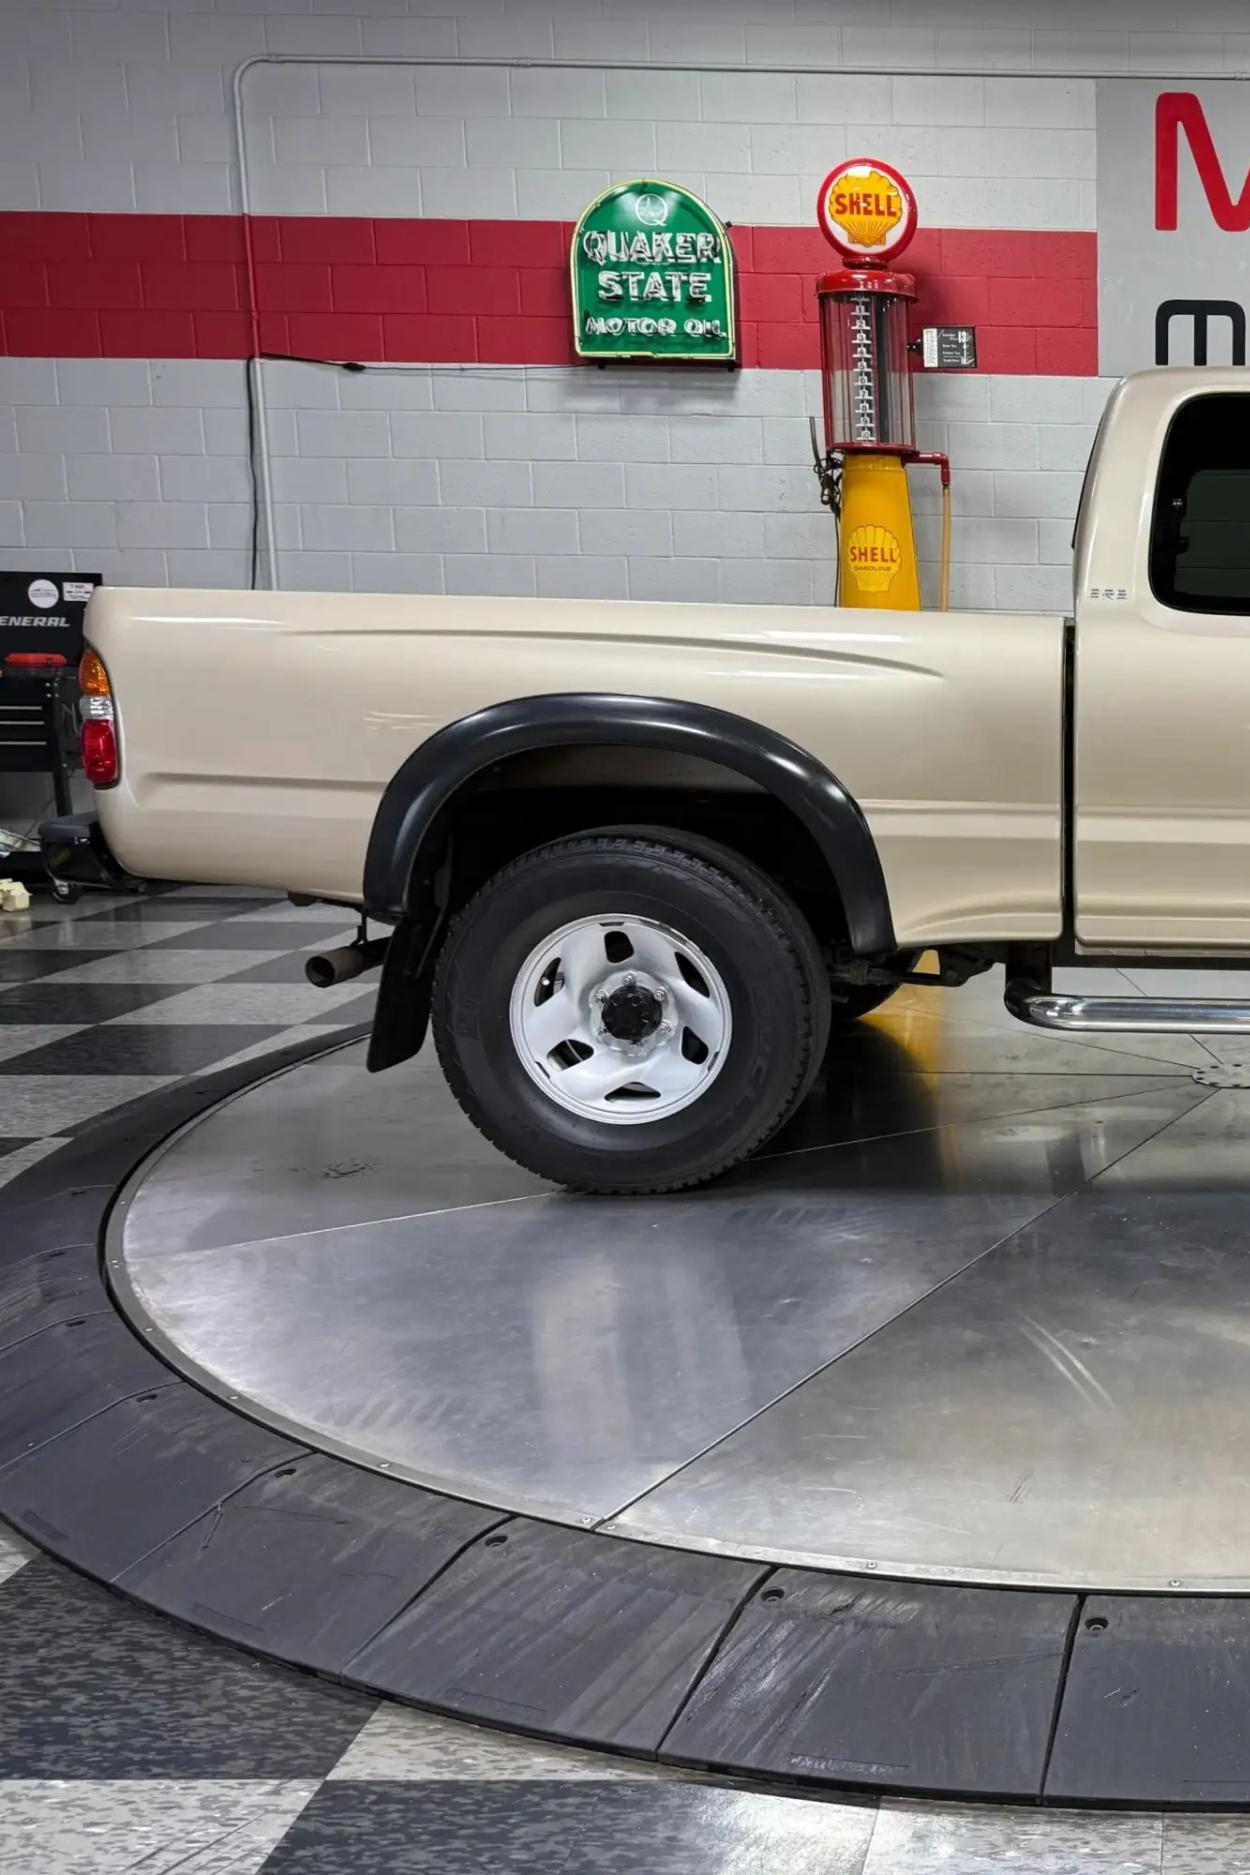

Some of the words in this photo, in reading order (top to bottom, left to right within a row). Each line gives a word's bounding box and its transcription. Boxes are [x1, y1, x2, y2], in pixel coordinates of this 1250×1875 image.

[834, 193, 897, 217] SHELL
[583, 230, 721, 265] QUAKER
[598, 271, 712, 303] STATE
[585, 317, 677, 336] MOTOR
[684, 319, 726, 337] OIL
[850, 546, 897, 563] SHELL
